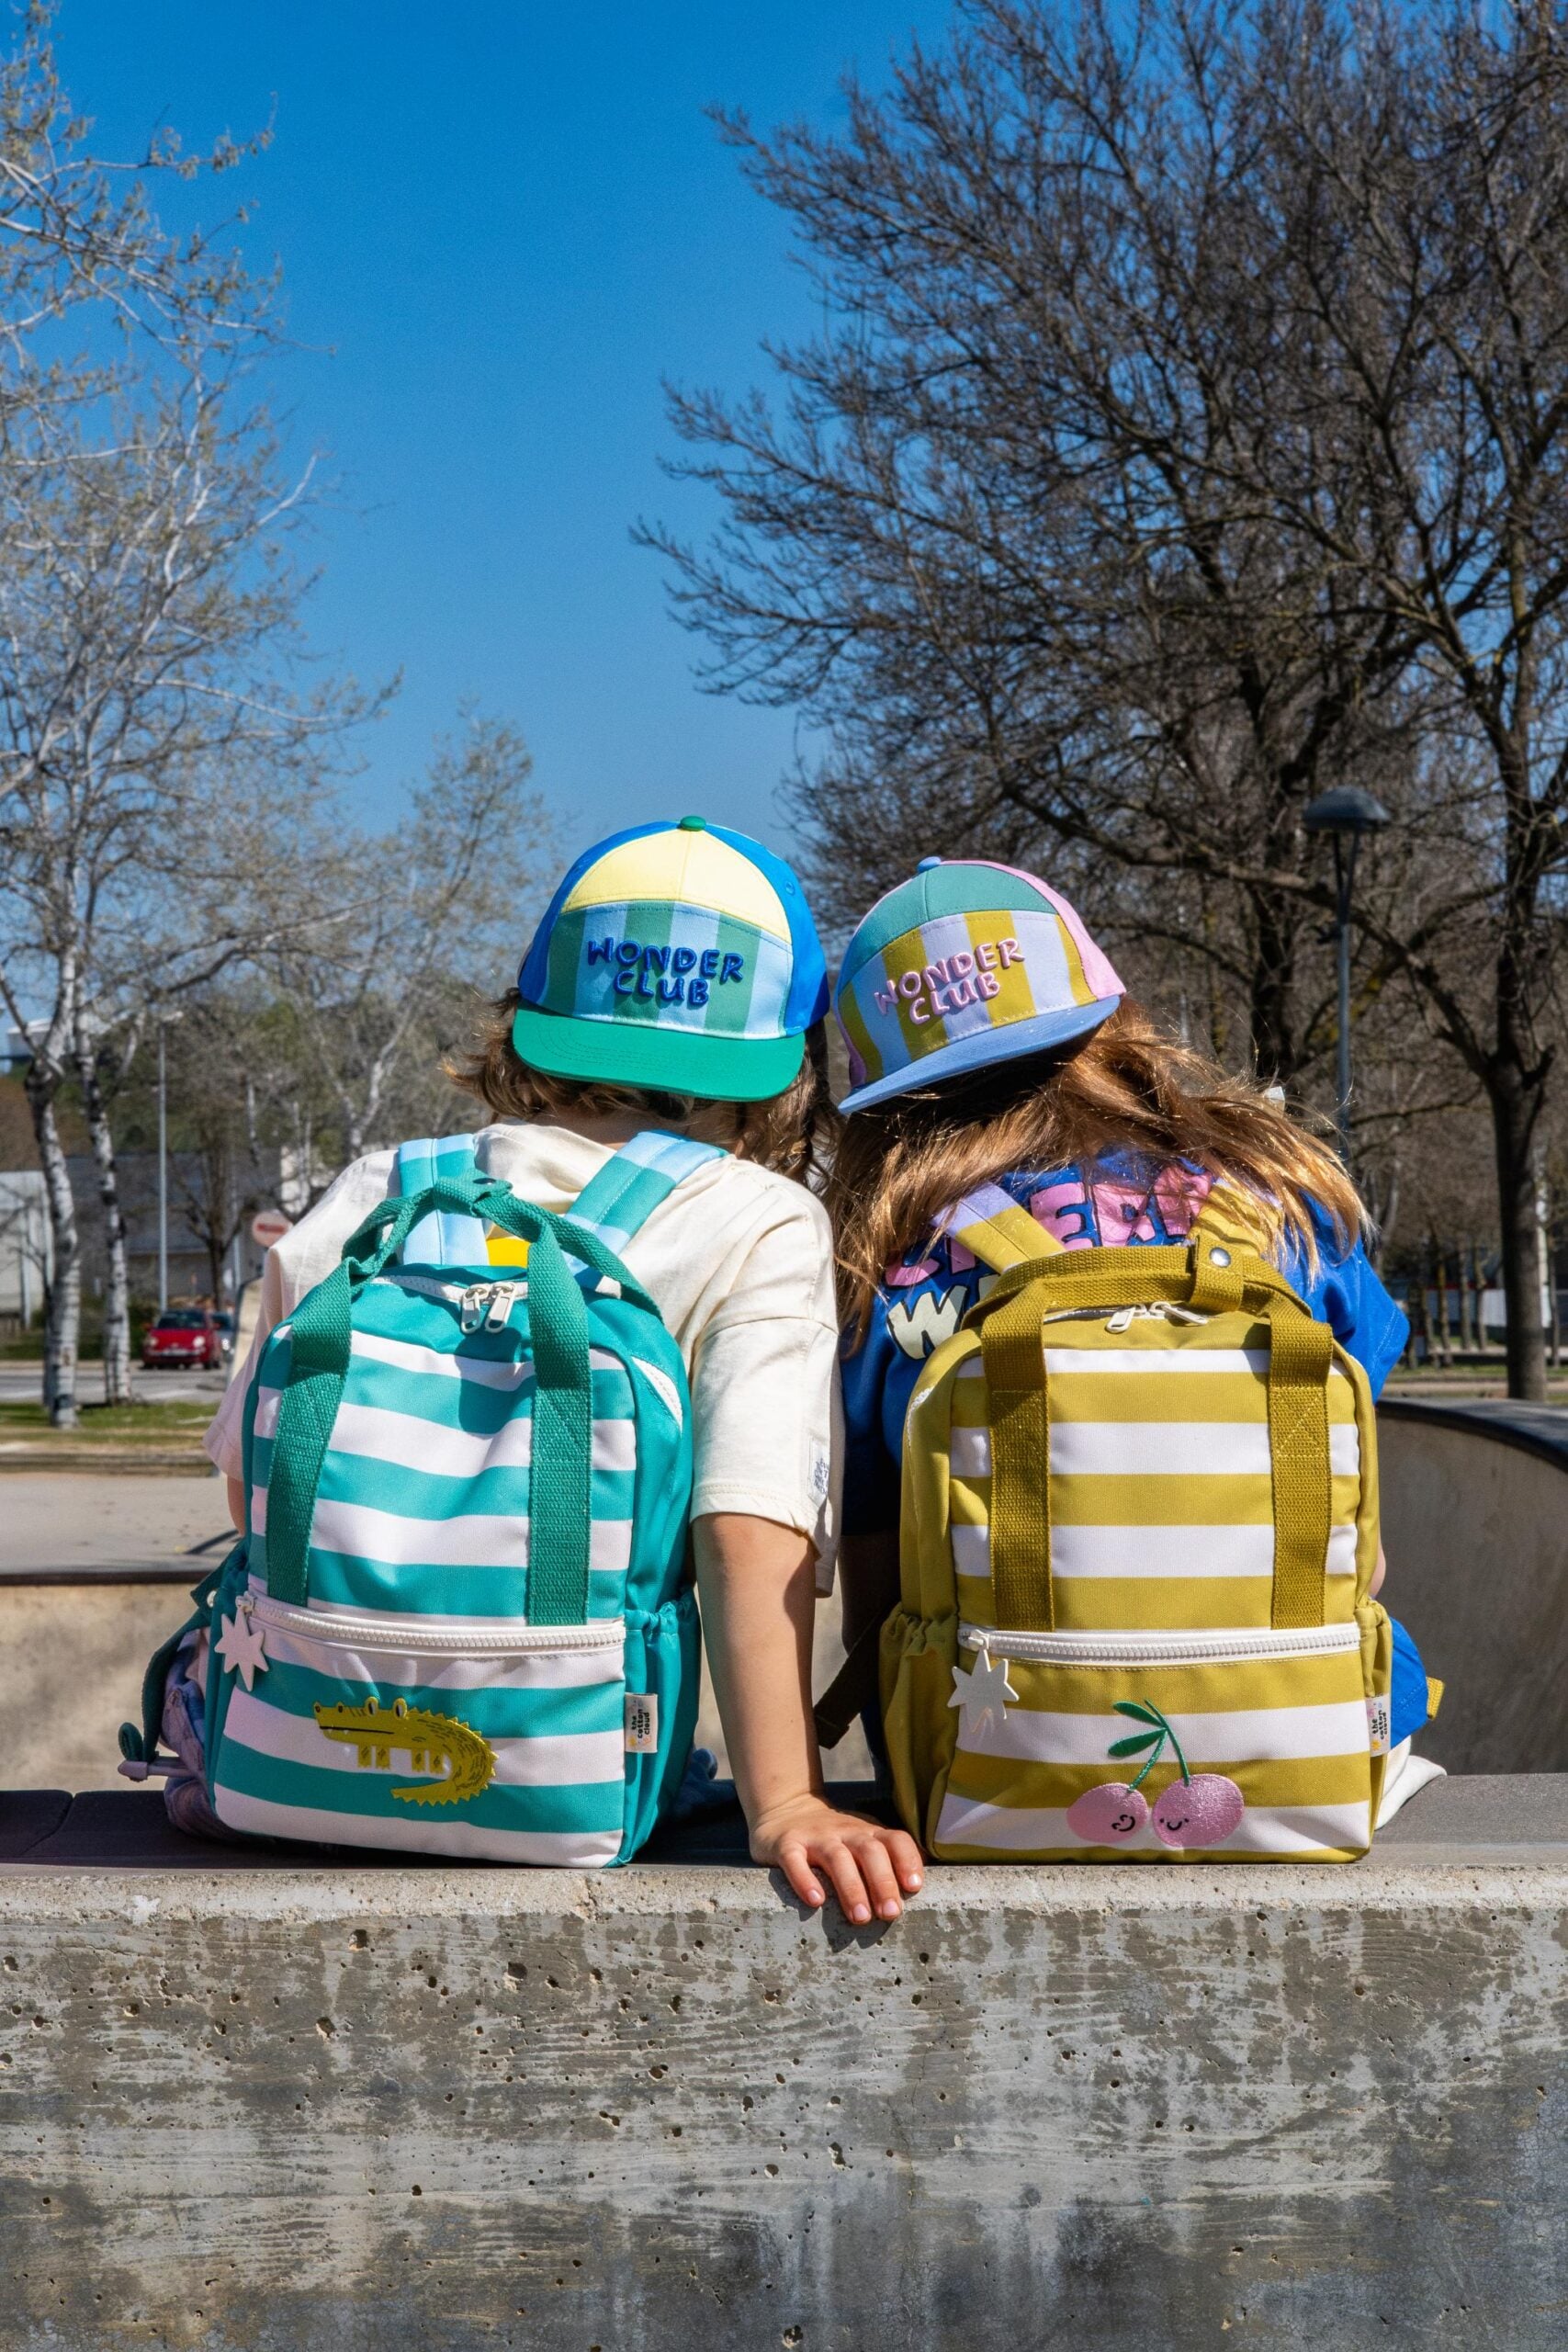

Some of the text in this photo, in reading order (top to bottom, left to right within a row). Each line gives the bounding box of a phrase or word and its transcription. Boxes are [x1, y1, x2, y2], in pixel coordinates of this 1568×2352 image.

[587, 937, 744, 985] WONDER
[874, 938, 1025, 1015] WONDER
[614, 970, 710, 1006] CLUB
[908, 971, 1000, 1025] CLUB
